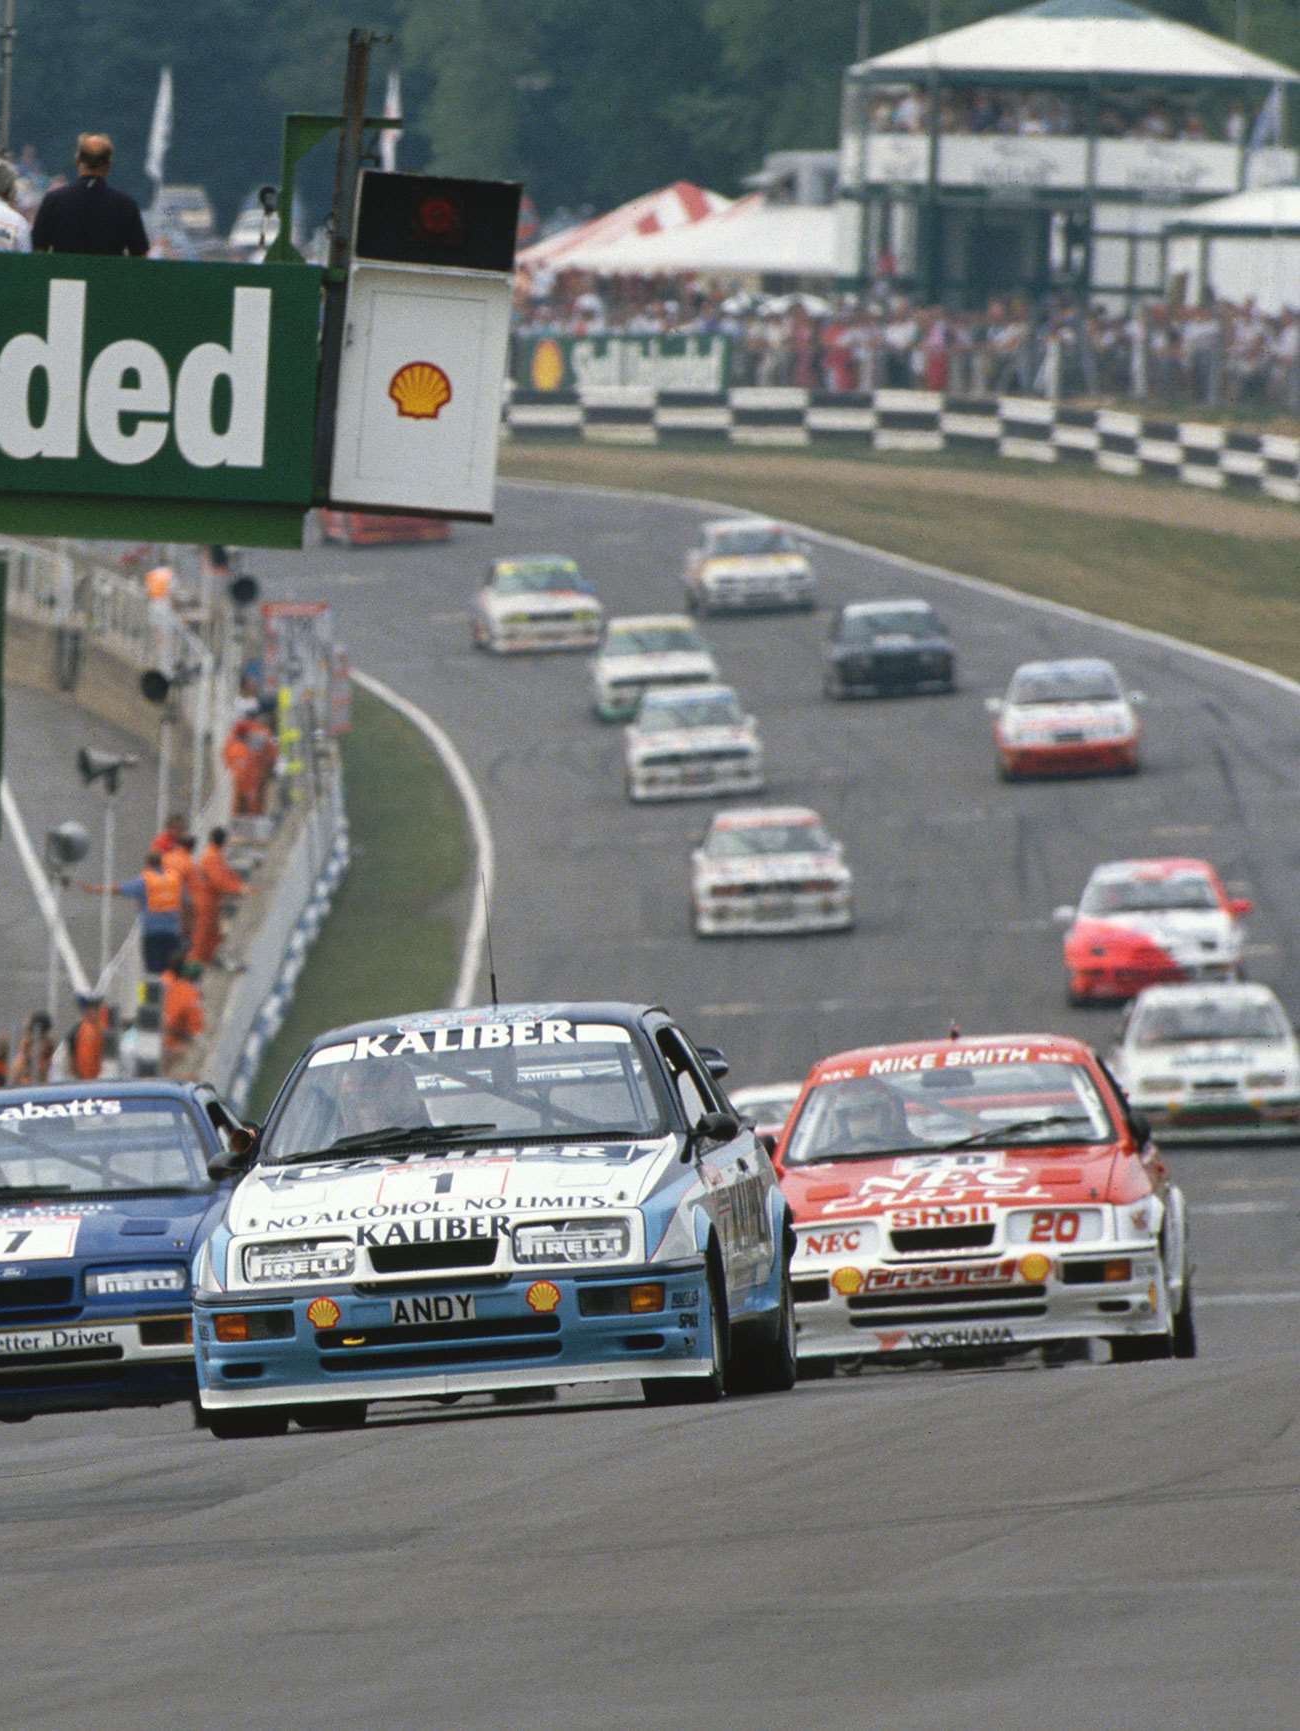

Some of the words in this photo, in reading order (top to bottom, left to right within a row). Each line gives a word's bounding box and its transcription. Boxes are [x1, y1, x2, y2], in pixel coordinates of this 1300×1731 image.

[354, 1020, 576, 1061] KALIBER
[869, 1053, 937, 1075] MIKE
[945, 1048, 1030, 1066] SMITH
[429, 1171, 454, 1194] 1
[858, 1167, 1031, 1195] NEC
[267, 1213, 307, 1231] NO
[316, 1200, 453, 1223] ALCOHOL.
[464, 1196, 507, 1211] NO
[515, 1195, 614, 1209] LIMITS.
[821, 1185, 1052, 1214] CARTEL
[356, 1214, 514, 1247] KALIBER
[892, 1206, 989, 1229] Shell
[1029, 1211, 1080, 1242] 20
[3, 1230, 32, 1253] 7
[519, 1228, 623, 1256] PIRELLI
[805, 1229, 861, 1256] NEC
[251, 1251, 348, 1277] PIRELLI
[97, 1270, 178, 1294] PIRELLI
[392, 1294, 474, 1322] ANDY
[52, 1328, 116, 1348] Driver
[908, 1328, 1014, 1348] YOKOHAMA
